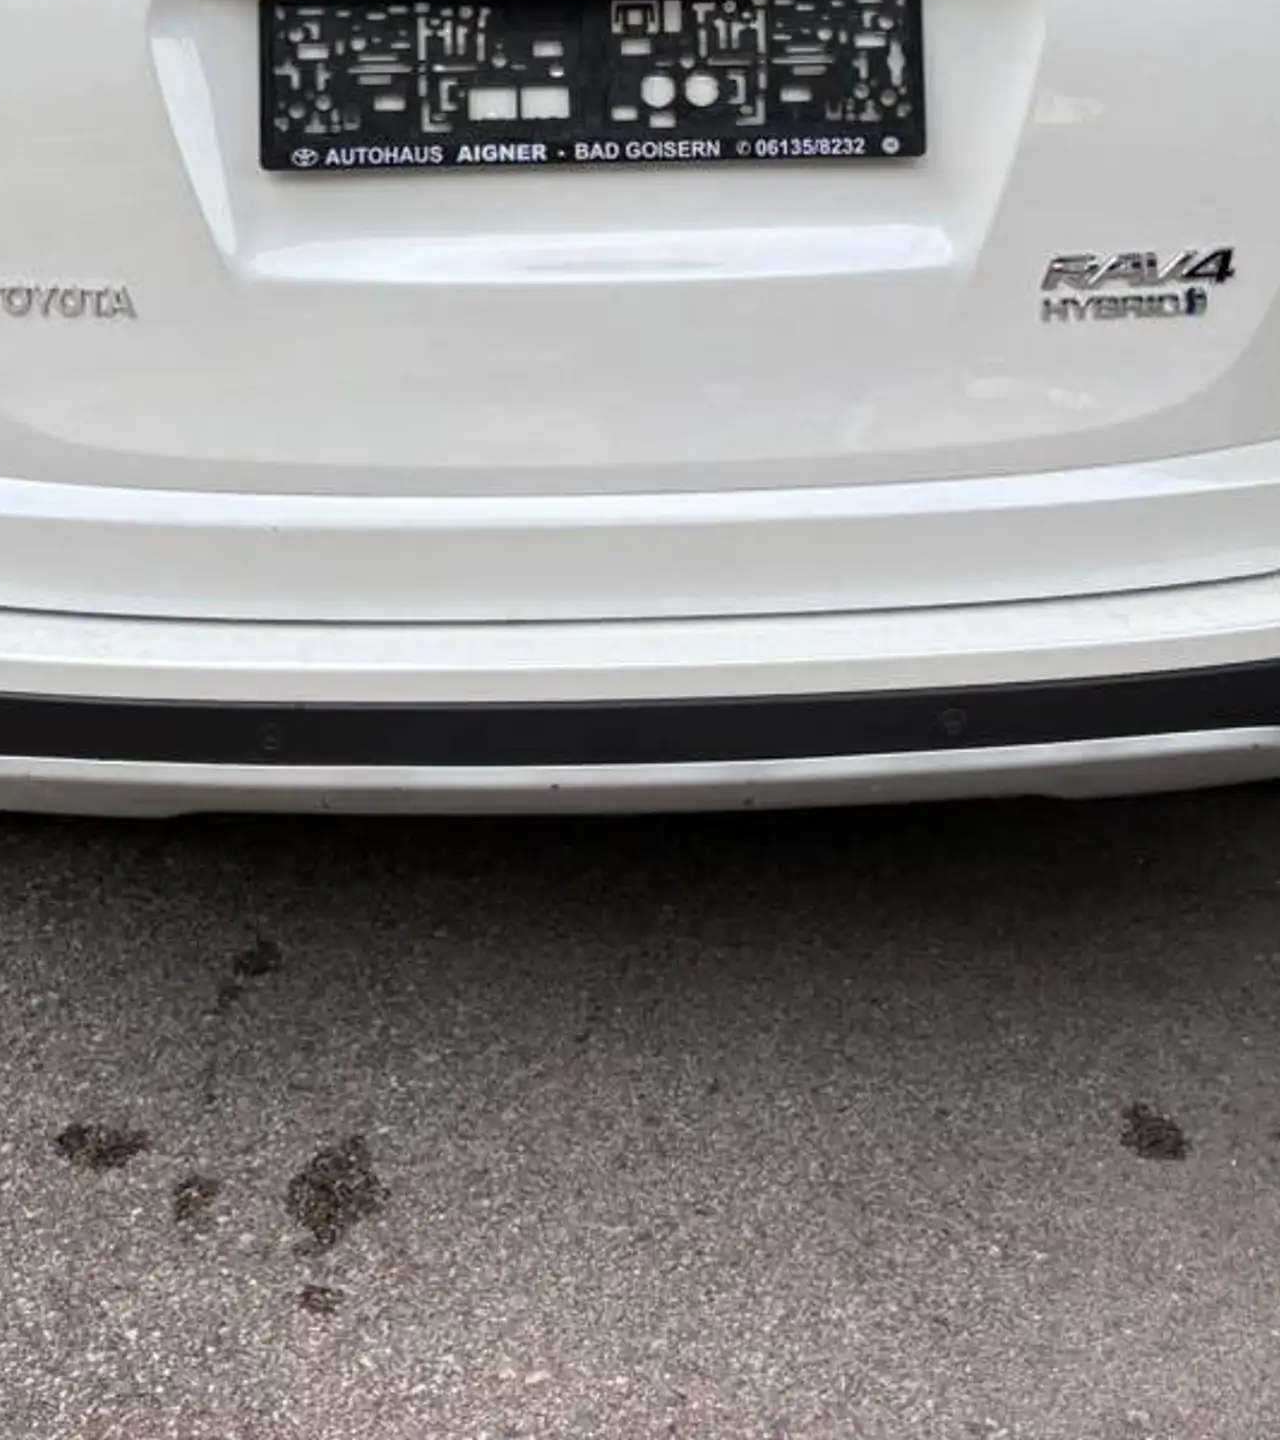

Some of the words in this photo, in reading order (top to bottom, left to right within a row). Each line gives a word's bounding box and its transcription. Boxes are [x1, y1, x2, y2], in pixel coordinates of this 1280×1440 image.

[324, 146, 444, 165] AUTOHAUS
[455, 143, 549, 163] AIGNER
[574, 142, 620, 160] BAD
[625, 139, 721, 159] GOISERN
[754, 137, 867, 157] 06135/8232
[1040, 247, 1235, 291] RAV4
[1041, 293, 1181, 323] HYBRID
